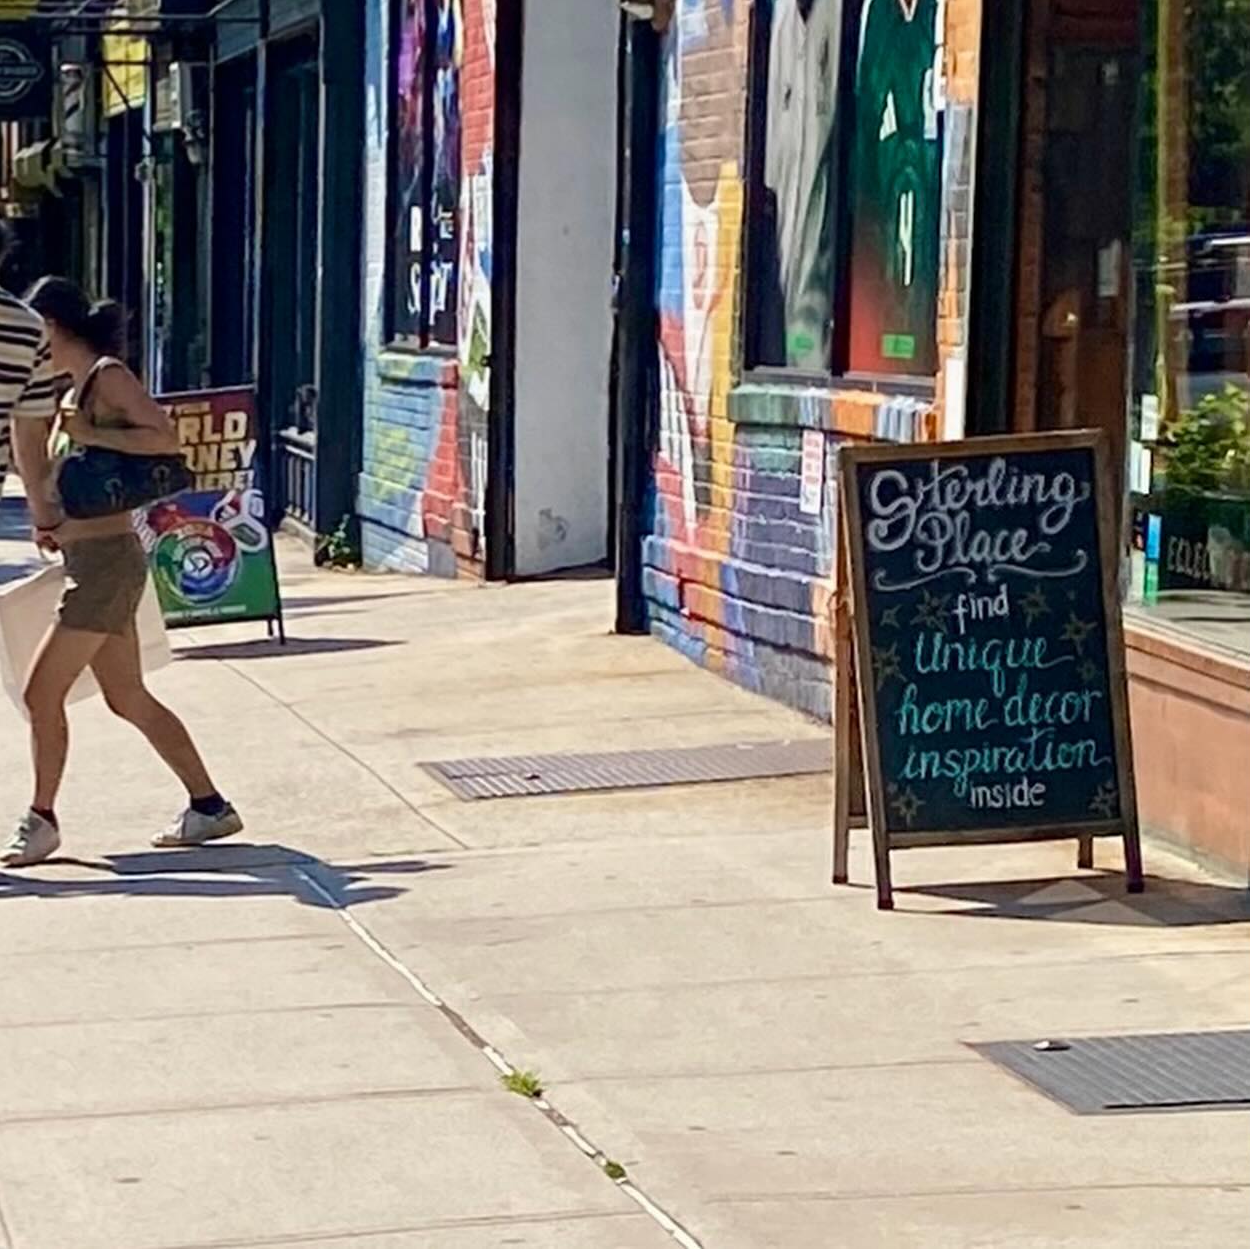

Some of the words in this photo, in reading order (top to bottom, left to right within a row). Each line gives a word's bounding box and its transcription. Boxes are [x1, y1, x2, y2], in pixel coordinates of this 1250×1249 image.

[177, 411, 248, 445] RLD
[869, 458, 1090, 551] Sterling
[914, 511, 1051, 573] Place
[953, 583, 1010, 635] find
[894, 683, 998, 736] home
[1003, 672, 1102, 725] decor
[898, 727, 1111, 797] inspiration
[970, 780, 1046, 808] inside
